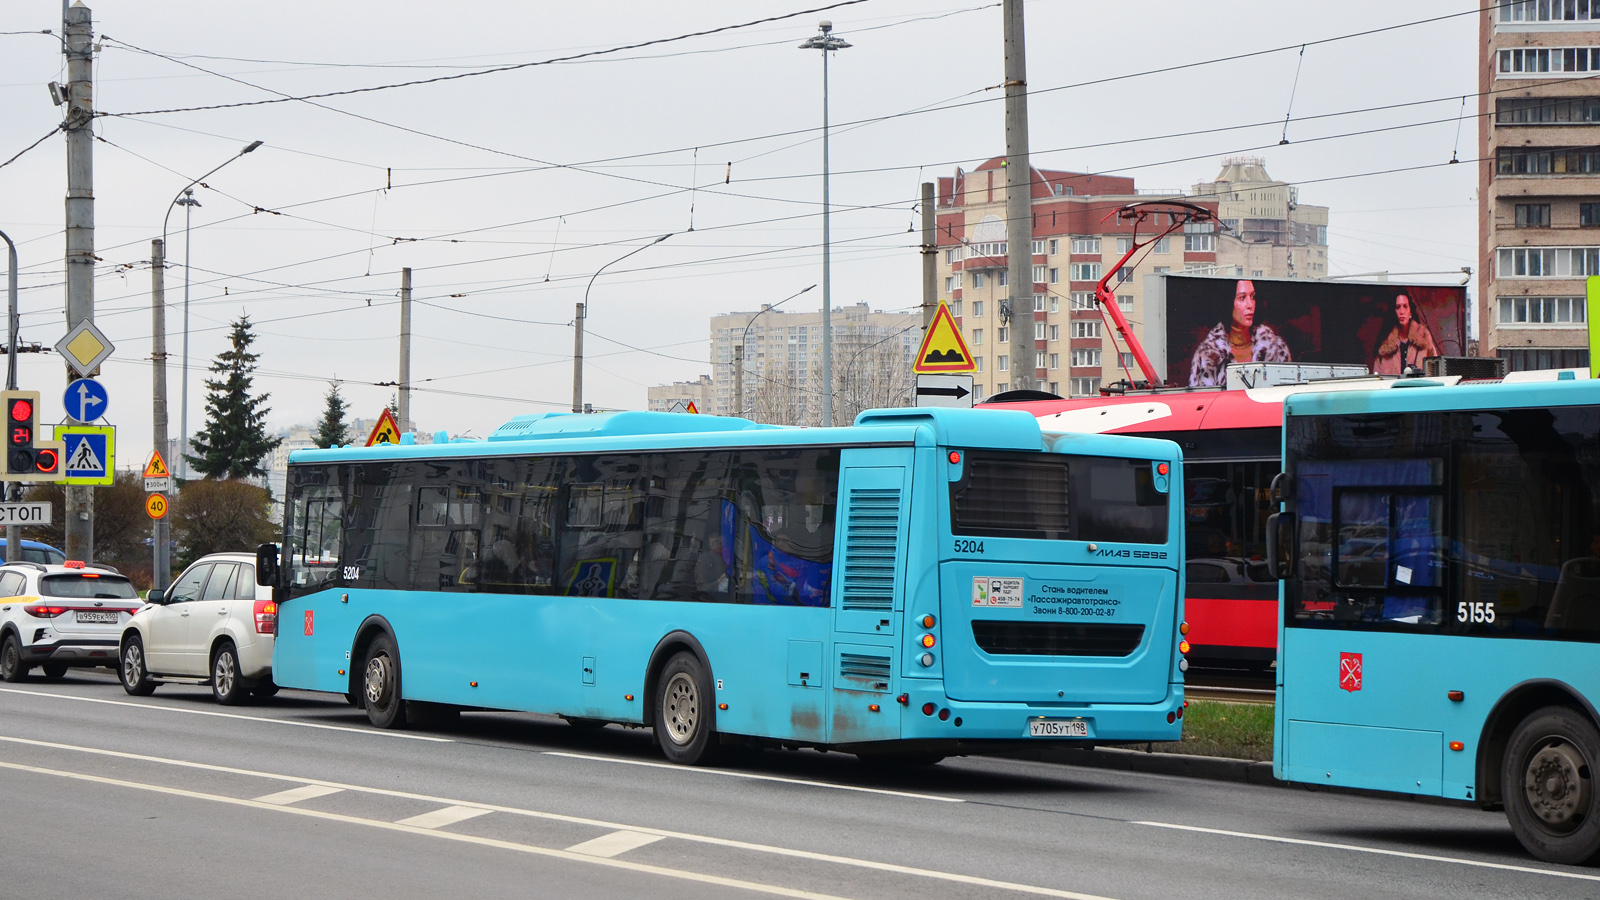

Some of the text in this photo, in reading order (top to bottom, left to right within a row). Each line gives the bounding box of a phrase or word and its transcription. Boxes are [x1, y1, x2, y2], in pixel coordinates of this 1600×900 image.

[13, 428, 29, 443] 24
[150, 501, 164, 512] 40
[954, 539, 985, 554] 5204
[1096, 549, 1168, 560] ЛИАЗ 5292
[342, 566, 360, 580] 5204
[1041, 584, 1109, 596] Стань водителем
[1033, 606, 1116, 617] Звони 8-800-200-02-87
[1457, 601, 1496, 624] 5155
